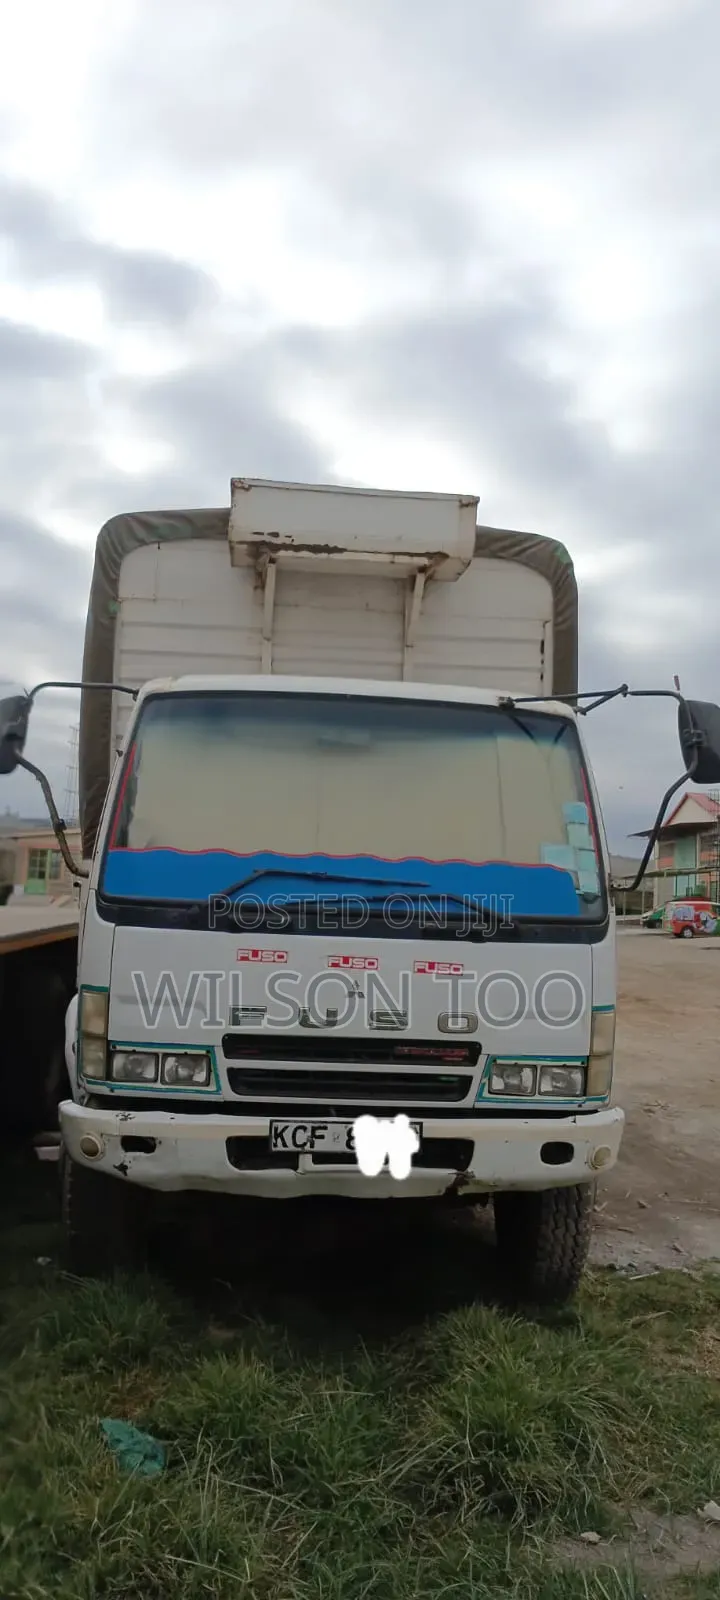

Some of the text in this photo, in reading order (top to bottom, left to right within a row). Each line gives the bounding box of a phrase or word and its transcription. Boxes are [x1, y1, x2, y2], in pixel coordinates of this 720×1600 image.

[237, 949, 288, 963] FUSO
[328, 956, 379, 970] FUSO
[414, 961, 464, 975] FUSO
[229, 1006, 479, 1034] FUSO
[272, 1125, 328, 1149] KCF
